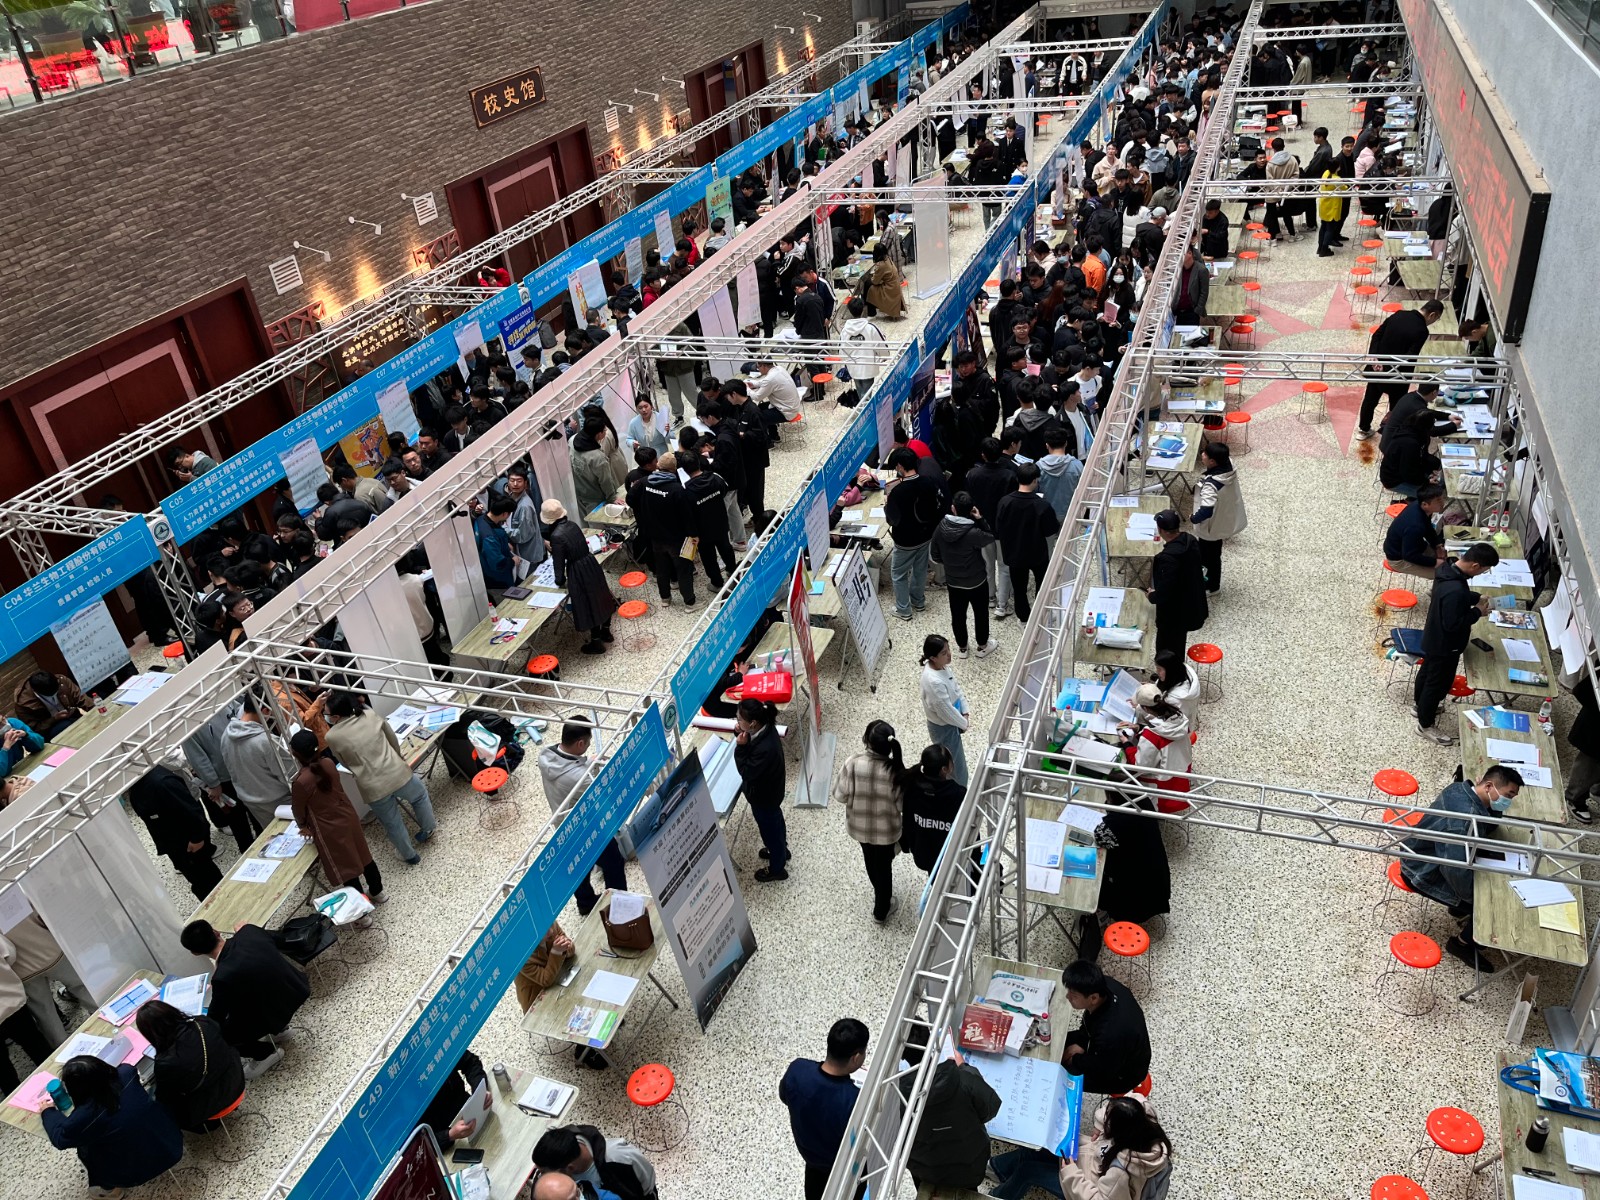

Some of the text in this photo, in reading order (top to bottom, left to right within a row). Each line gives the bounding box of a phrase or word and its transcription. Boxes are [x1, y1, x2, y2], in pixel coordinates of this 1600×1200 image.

[483, 78, 536, 117] 校史馆
[168, 449, 256, 509] C05 华兰基因工程有限公司
[3, 531, 123, 609] C04 华兰生物工程股份有限公司
[673, 667, 689, 687] C51
[914, 813, 951, 832] FRIENDS
[536, 846, 557, 872] C50
[355, 888, 527, 1120] C49 新乡市盛世汽车销售服务有限公司
[415, 966, 503, 1087] 汽车销售顾问、销售代表
